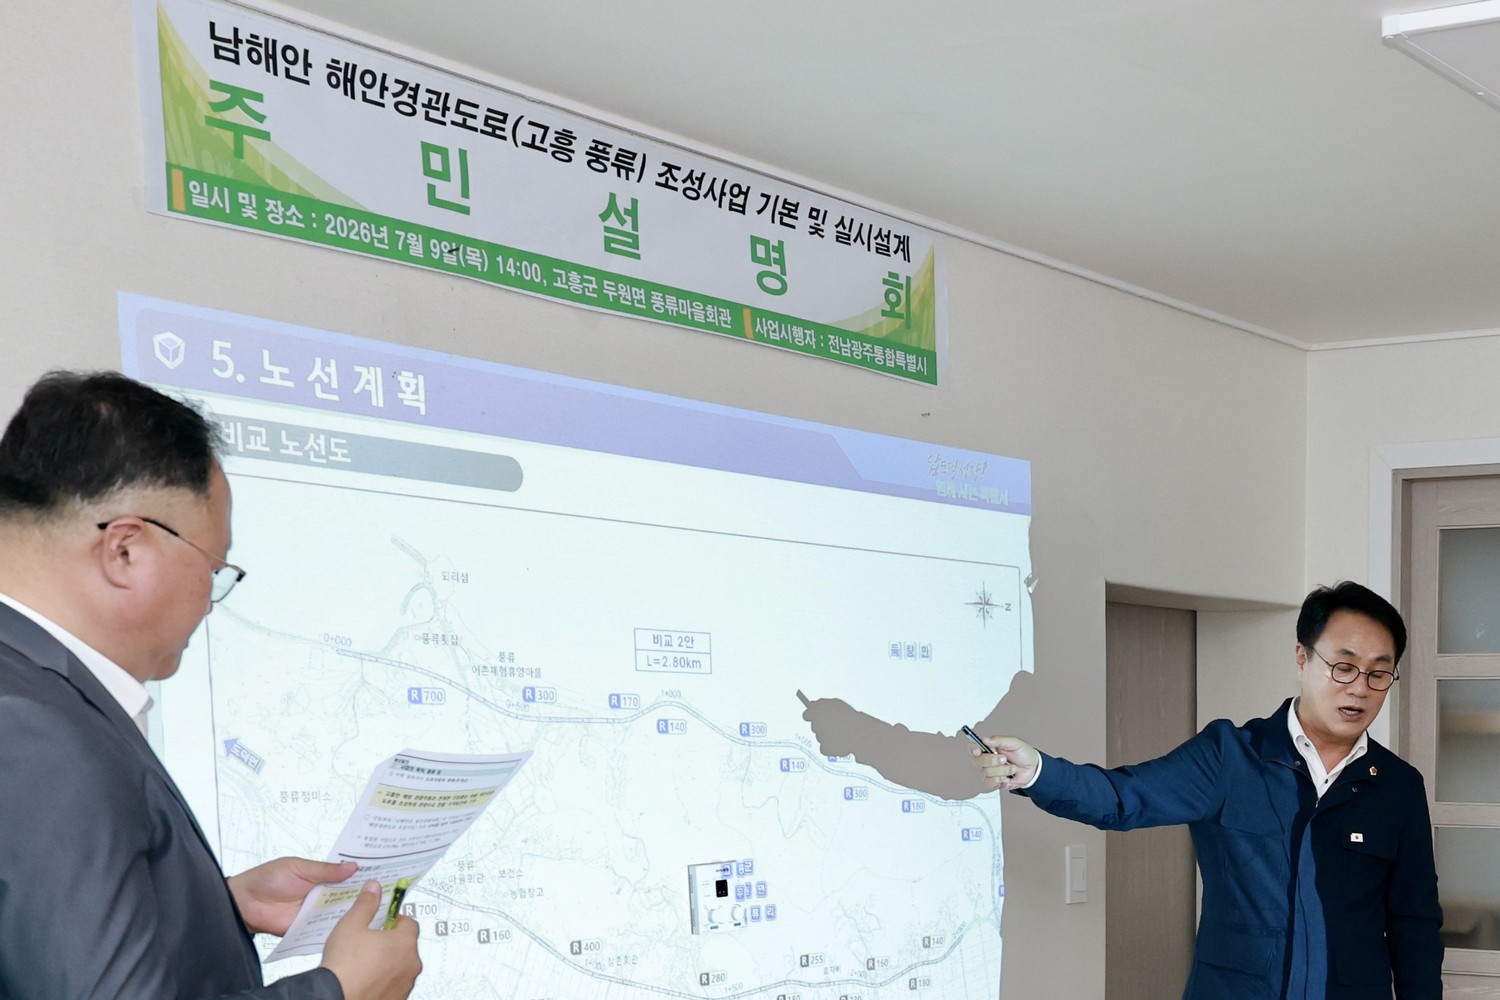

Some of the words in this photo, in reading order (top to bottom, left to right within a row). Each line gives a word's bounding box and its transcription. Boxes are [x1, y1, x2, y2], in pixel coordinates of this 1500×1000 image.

[208, 21, 312, 86] 남해안
[326, 58, 577, 163] 해안경관도로(고흥
[585, 138, 647, 184] 풍류)
[655, 161, 751, 215] 조성사업
[756, 189, 800, 230] 기본
[807, 206, 826, 239] 및
[834, 215, 912, 263] 실시설계
[205, 80, 271, 160] 주
[421, 140, 471, 216] 민
[598, 192, 642, 261] 설
[749, 234, 788, 297] 명
[882, 270, 912, 330] 회
[189, 180, 231, 214] 일시
[238, 192, 258, 220] 및
[264, 199, 305, 230] 장소
[325, 213, 389, 250] 2026년
[395, 231, 424, 259] 7월
[430, 238, 489, 273] 9일(목)
[495, 254, 547, 287] 14:00,
[552, 267, 599, 299] 고흥군
[603, 280, 647, 310] 두원면
[650, 291, 732, 329] 풍류마을회관
[755, 317, 816, 350] 사업시행자
[828, 334, 928, 376] 전남광주통합특별시
[212, 339, 245, 384] 5.
[280, 430, 352, 464] 노선도
[652, 634, 673, 647] 비교
[678, 636, 695, 649] 2안
[647, 655, 702, 669] L=2.80km
[424, 690, 444, 702] 700
[537, 689, 555, 701] 300
[622, 696, 639, 708] 170
[669, 721, 685, 732] 140
[791, 760, 805, 771] 140
[418, 904, 438, 915] 700
[450, 922, 470, 933] 230
[493, 930, 511, 941] 160
[583, 941, 601, 952] 400
[711, 973, 726, 983] 280
